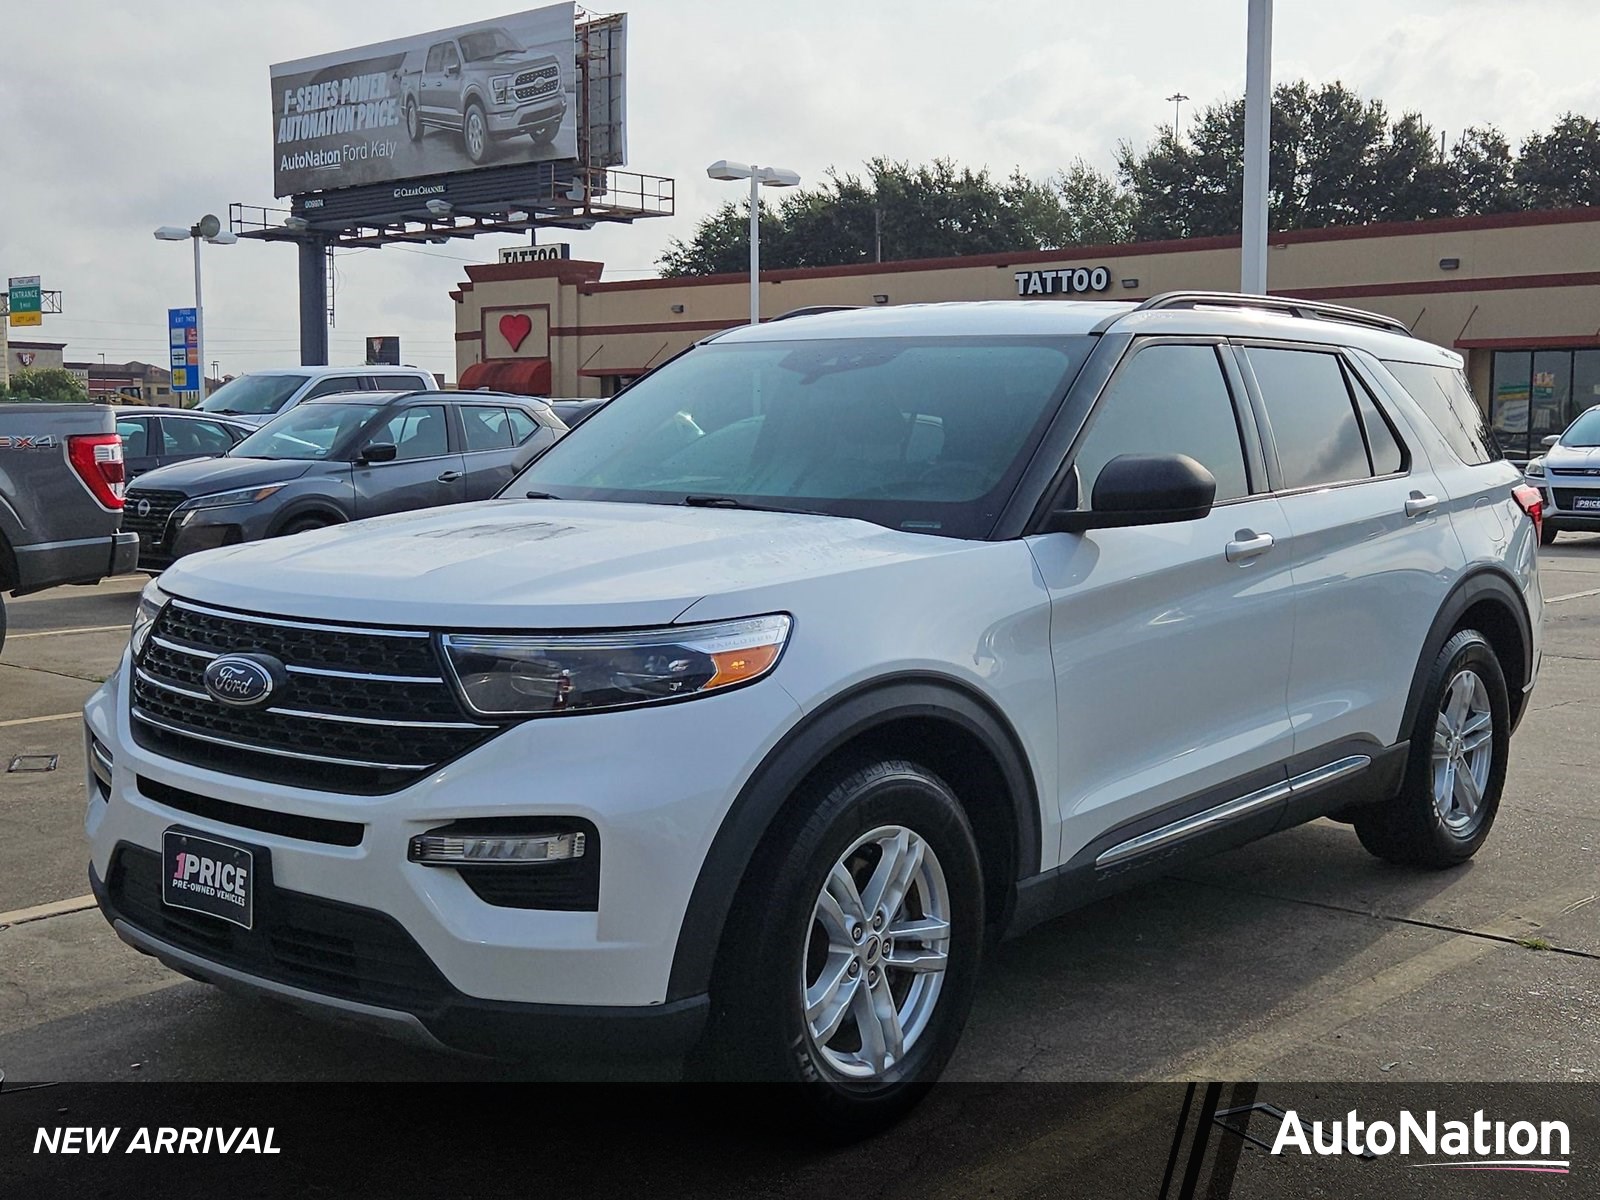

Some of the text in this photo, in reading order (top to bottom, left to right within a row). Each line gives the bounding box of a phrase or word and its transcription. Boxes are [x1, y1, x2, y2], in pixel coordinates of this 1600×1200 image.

[284, 73, 390, 115] F-SERIES POWER.
[277, 99, 399, 144] AUTONATION PRICE.
[280, 139, 397, 172] AutoNation Ford Katy
[503, 248, 558, 263] TATTOO
[11, 290, 38, 299] ENTRANCE
[1014, 267, 1109, 296] TATTOO
[215, 666, 253, 695] Ford
[172, 878, 246, 908] PRE-OWNED VEHICLES
